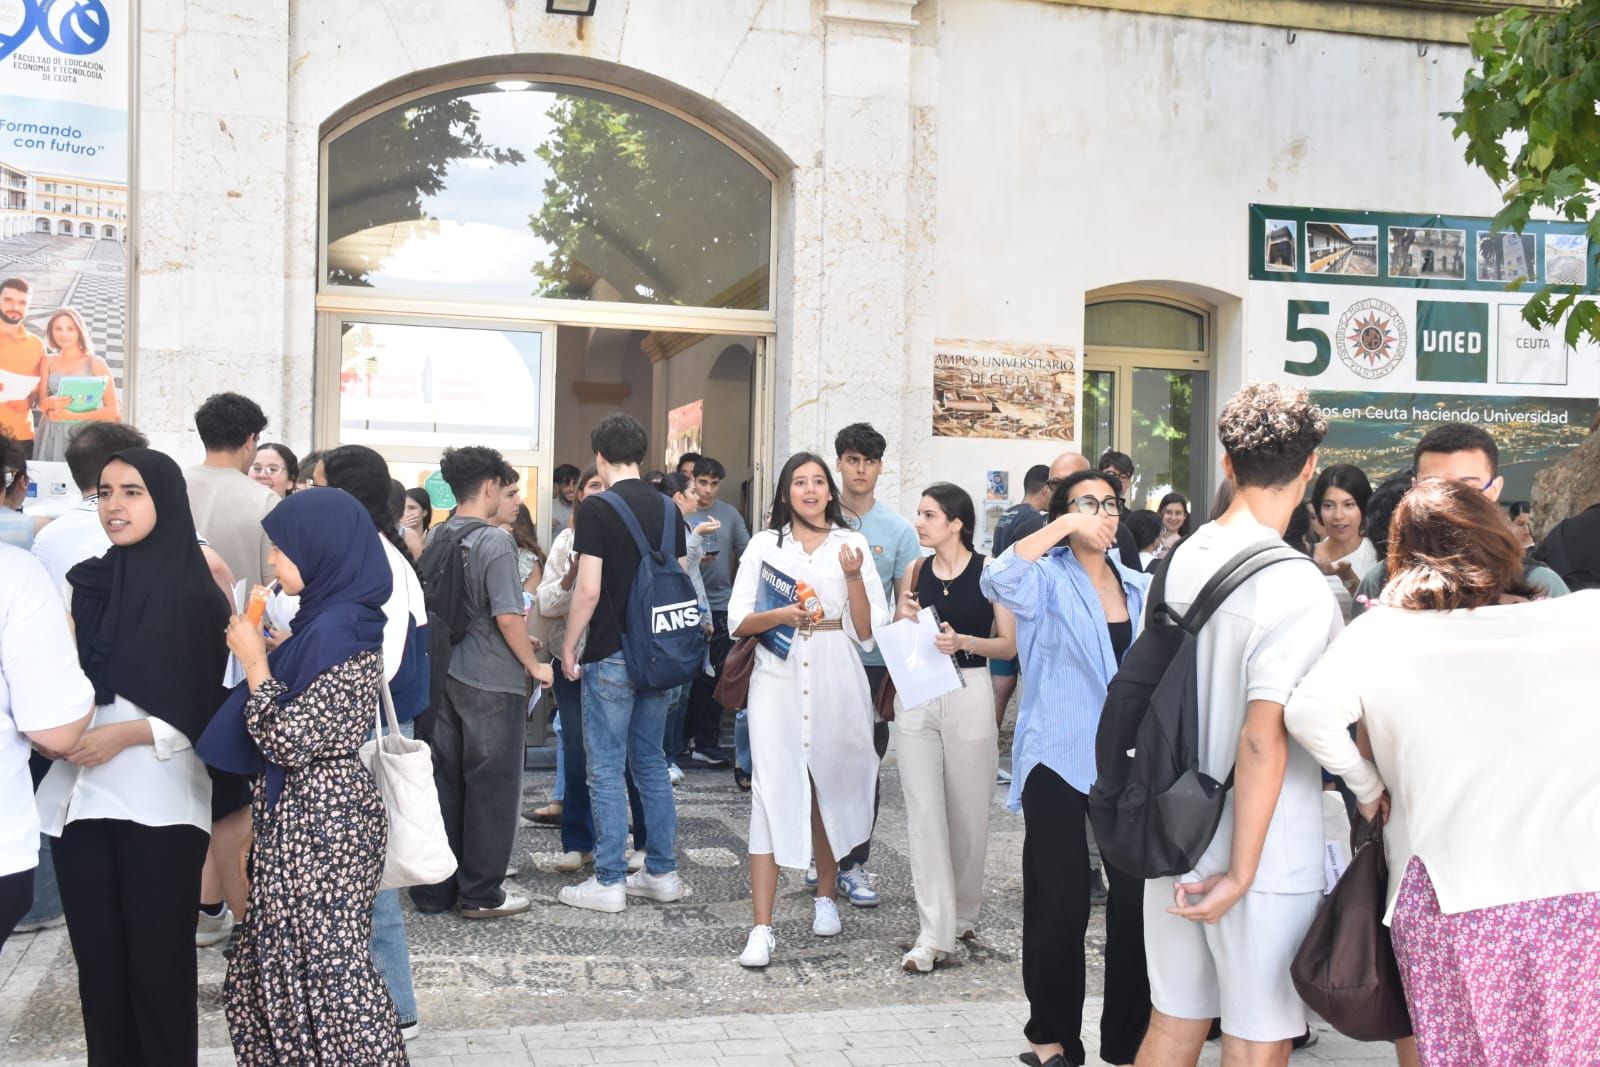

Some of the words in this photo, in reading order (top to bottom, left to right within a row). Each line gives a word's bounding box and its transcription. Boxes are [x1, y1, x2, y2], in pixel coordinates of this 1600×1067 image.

[13, 53, 51, 65] FACULTAD
[64, 58, 106, 72] EDUCACIÓN,
[13, 62, 51, 73] ECONOMÍA
[60, 67, 103, 80] TECNOLOGÍA
[54, 75, 78, 83] CEUTA
[14, 138, 45, 150] con
[1423, 329, 1482, 354] UNED
[1516, 337, 1550, 349] CEUTA
[934, 353, 978, 367] AMPUS
[982, 354, 1074, 371] UNIVERSITARIO
[970, 372, 986, 384] DE
[990, 373, 1031, 386] CEUTA
[1343, 407, 1361, 419] en
[1365, 406, 1408, 420] Ceuta
[1412, 407, 1480, 423] haciendo
[1484, 409, 1568, 424] Universidad
[762, 568, 792, 595] OUTLOOK
